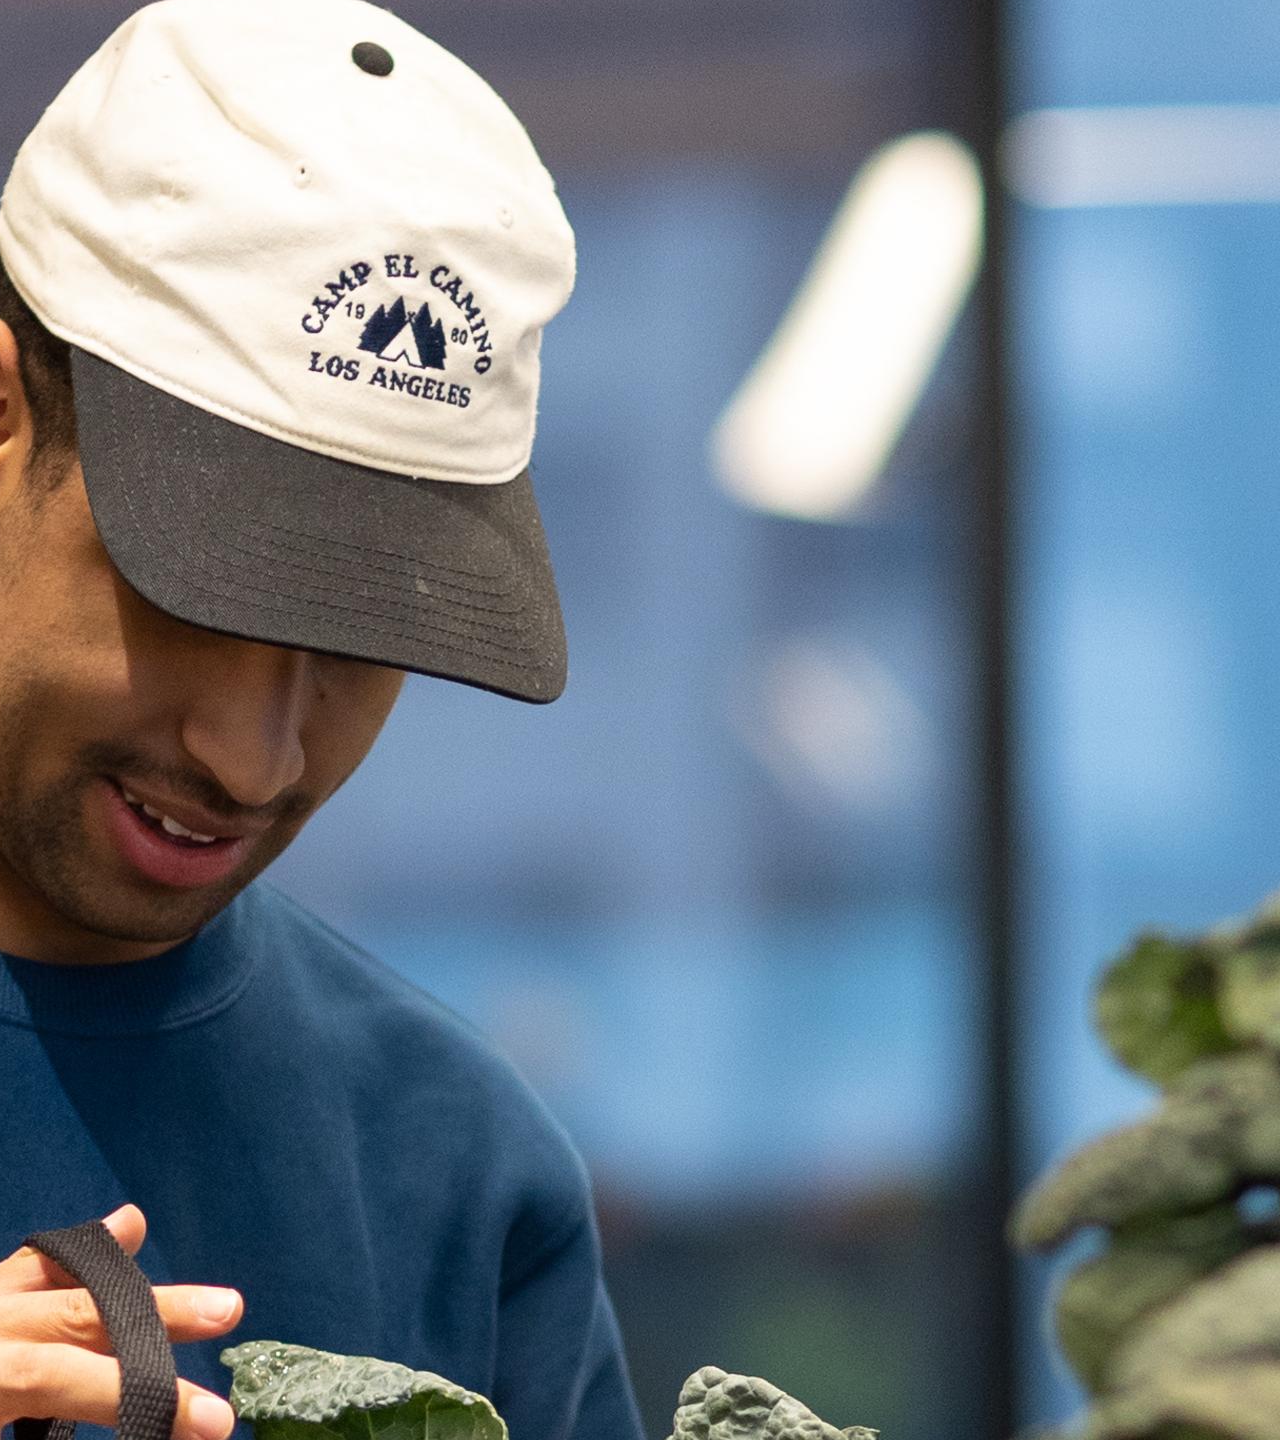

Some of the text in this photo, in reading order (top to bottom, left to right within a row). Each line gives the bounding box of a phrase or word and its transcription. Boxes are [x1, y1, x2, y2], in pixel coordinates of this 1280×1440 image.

[301, 254, 493, 376] CAMP EL CAMINO
[345, 301, 468, 346] 19 80
[308, 351, 471, 409] LOS ANGELES
